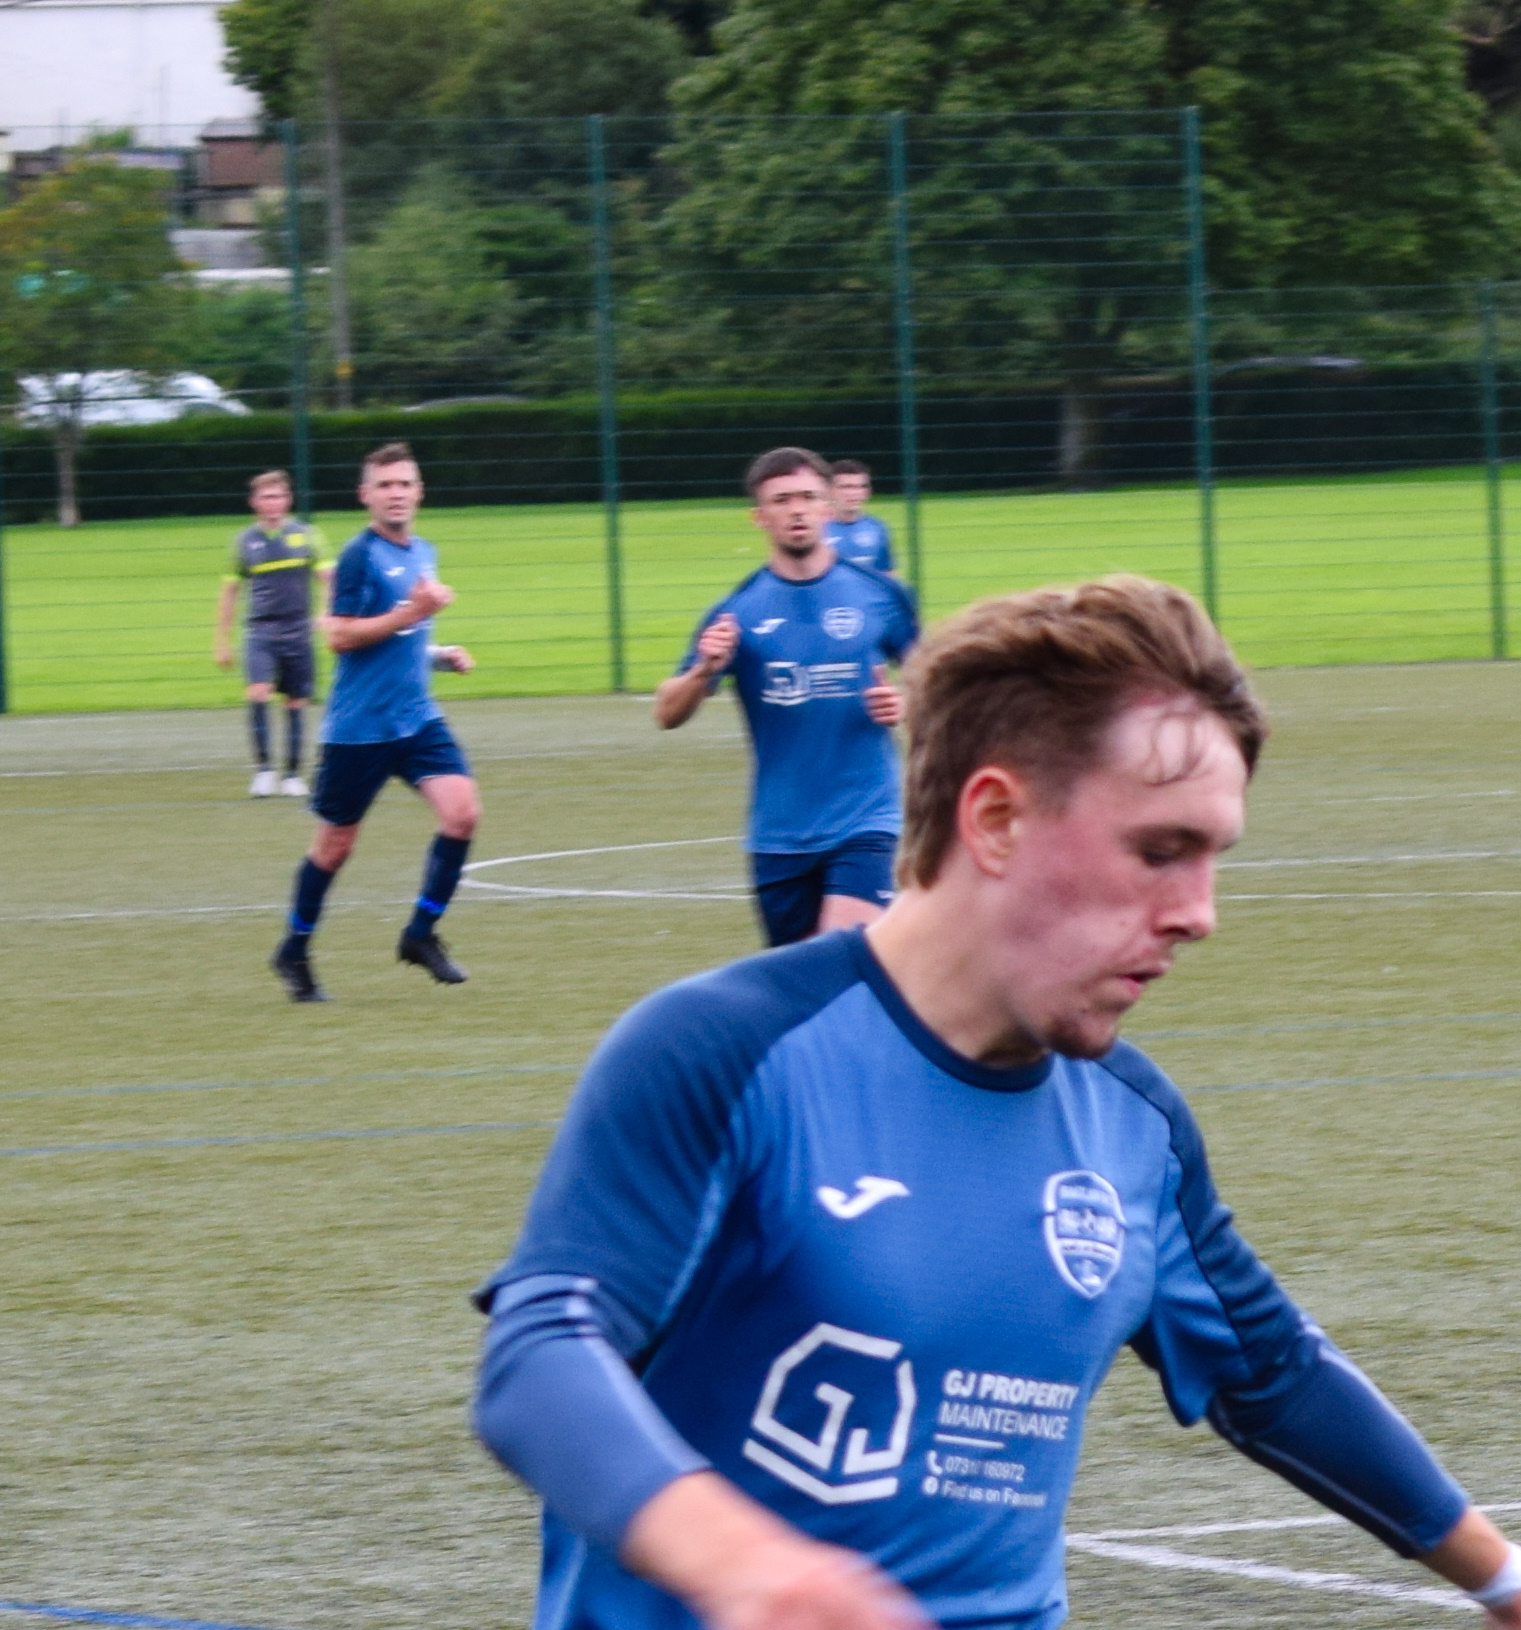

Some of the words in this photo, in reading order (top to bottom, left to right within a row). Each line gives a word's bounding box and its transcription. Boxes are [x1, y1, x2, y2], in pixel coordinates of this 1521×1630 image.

[944, 1369, 977, 1397] GJ
[979, 1373, 1080, 1409] PROPERTY
[939, 1401, 1070, 1440] MAINTENANCE
